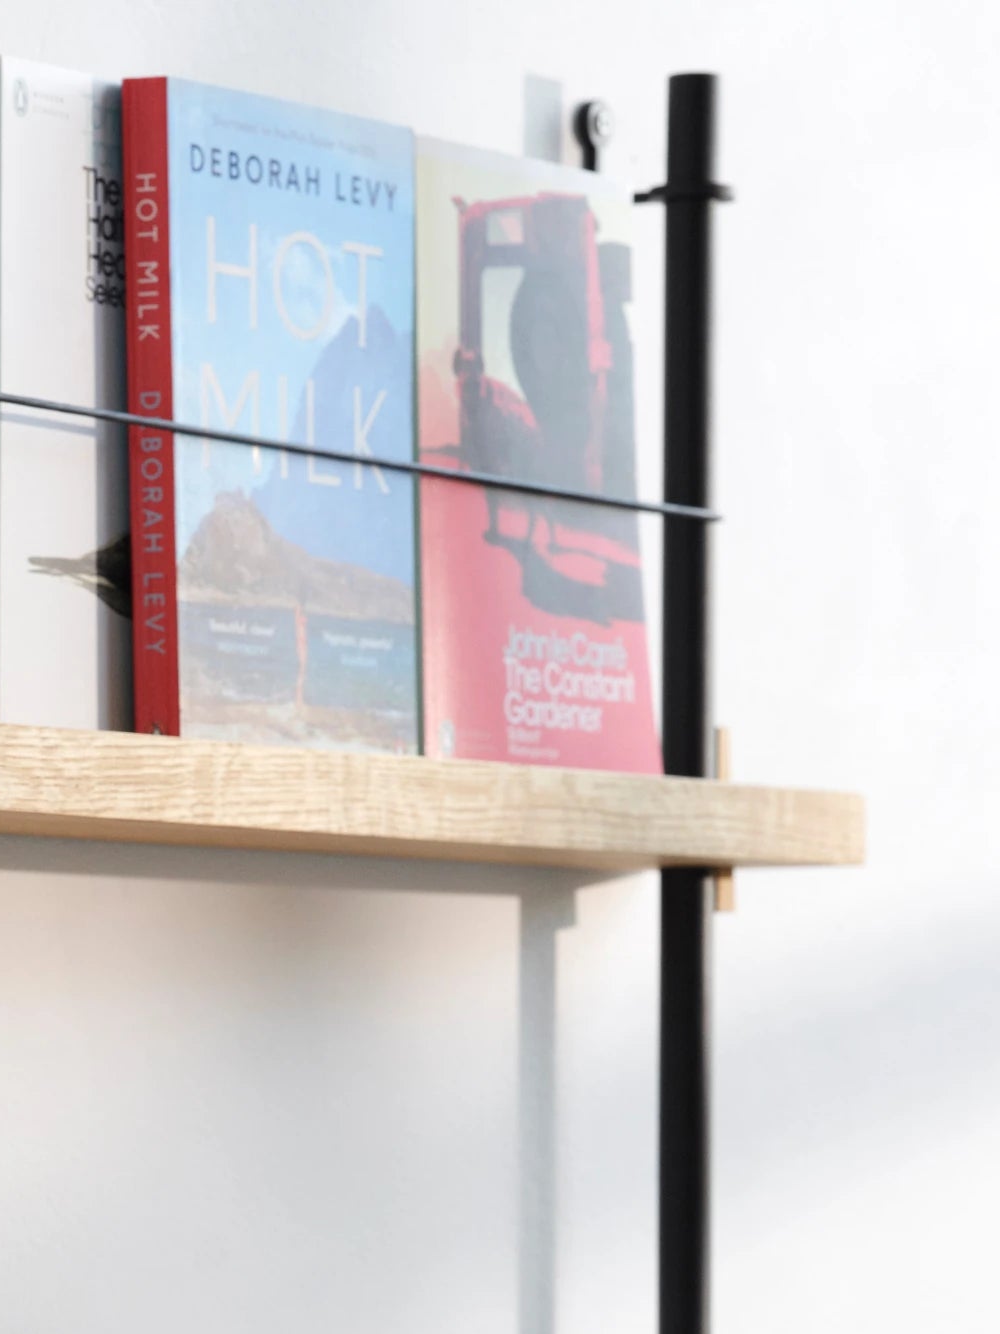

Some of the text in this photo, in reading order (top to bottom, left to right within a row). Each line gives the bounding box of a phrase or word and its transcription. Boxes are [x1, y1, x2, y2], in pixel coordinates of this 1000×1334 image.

[83, 165, 122, 206] The
[189, 143, 398, 213] DEBORAH LEVY
[205, 215, 384, 348] HOT
[136, 173, 166, 656] HOT MILK DBORAH LEVY
[199, 362, 391, 495] MILK
[502, 655, 637, 704] The Constant
[503, 690, 603, 733] Gardener
